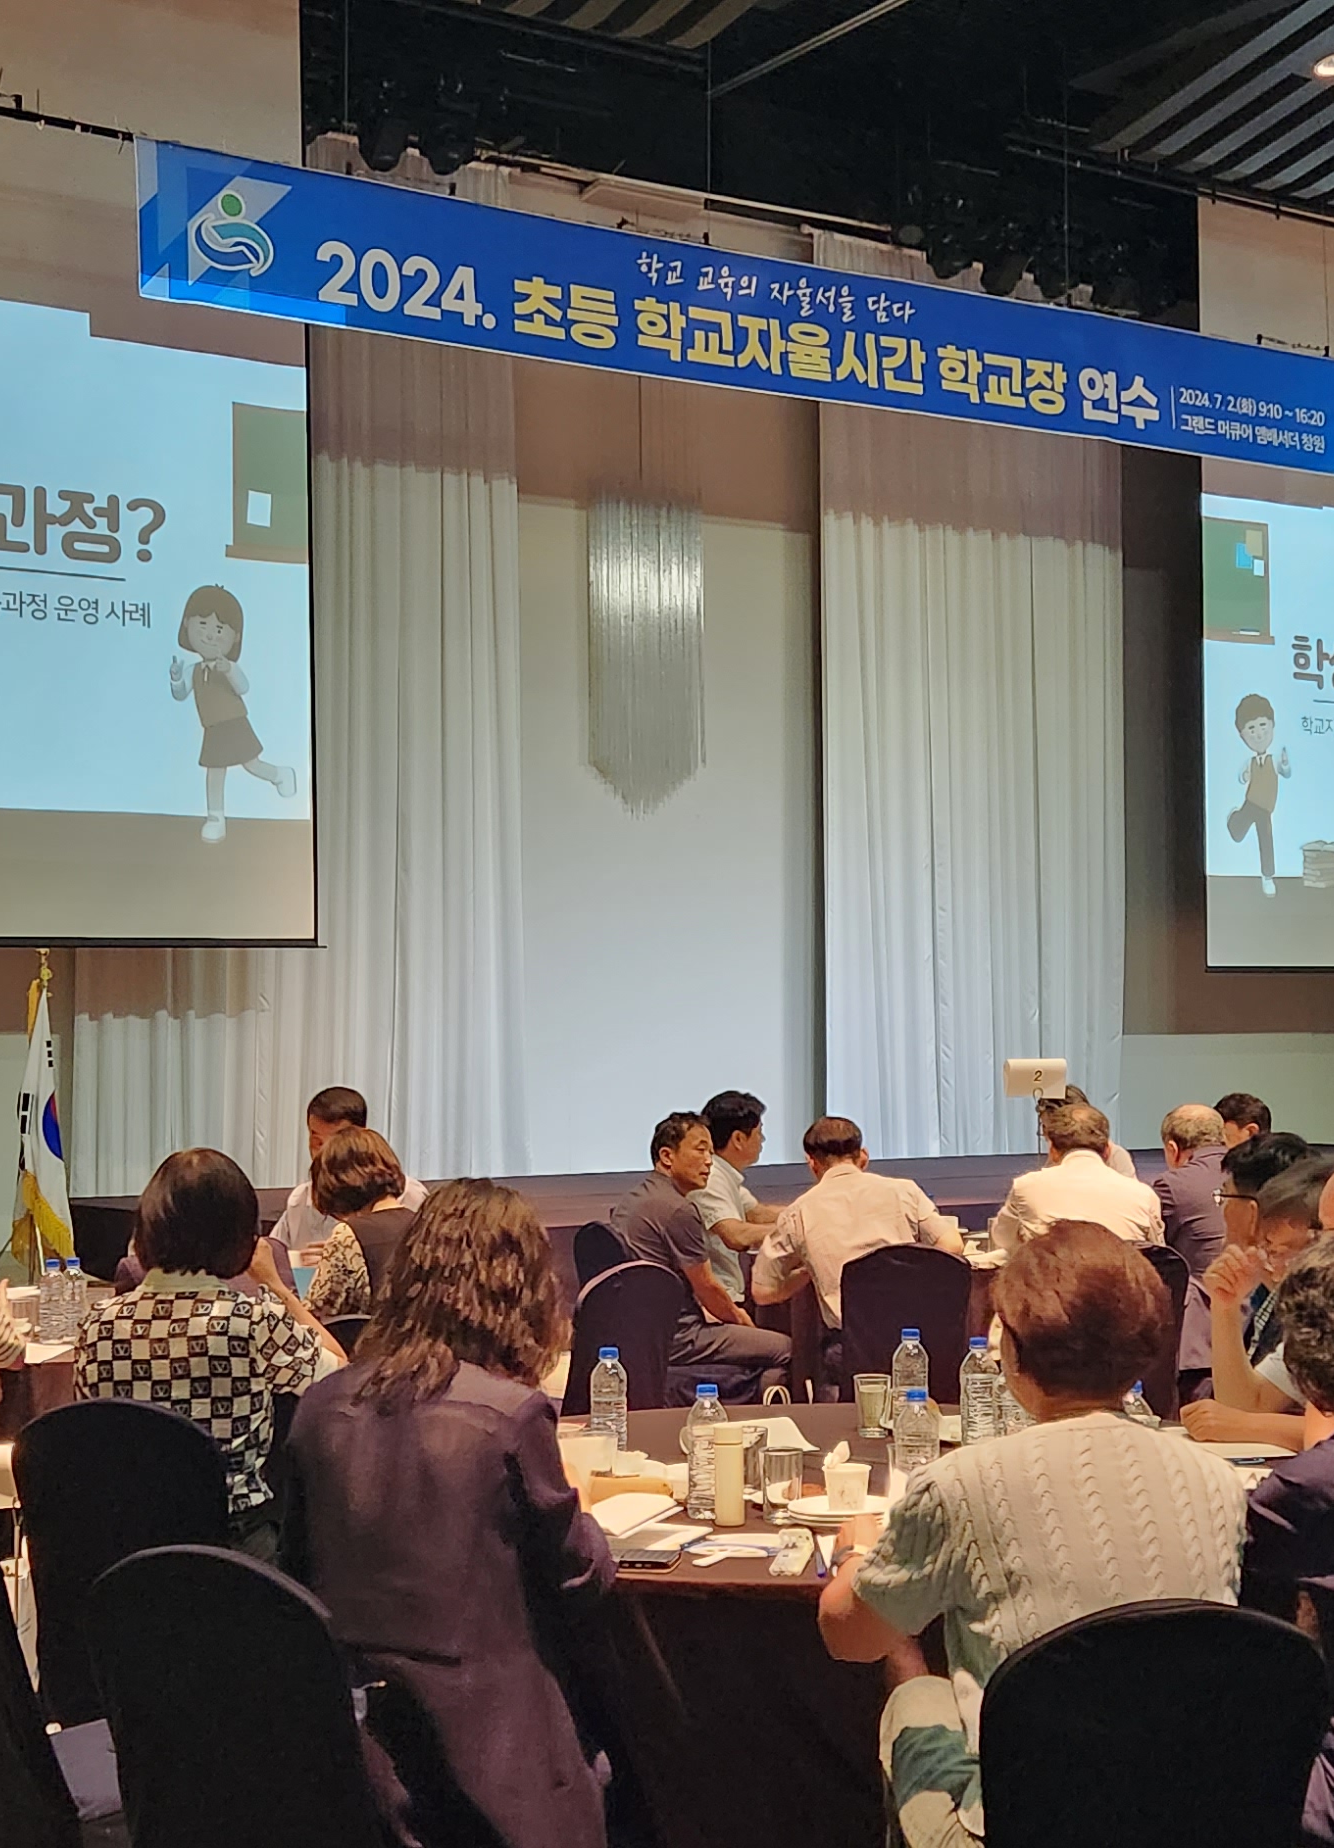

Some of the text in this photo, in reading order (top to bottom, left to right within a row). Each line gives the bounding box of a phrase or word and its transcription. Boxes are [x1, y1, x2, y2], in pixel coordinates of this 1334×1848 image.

[637, 251, 916, 324] 학교 교육의 자율성을 담다
[316, 240, 1160, 430] 2024. 초등 학교자율시간 학교장 연수
[1180, 414, 1216, 435] 그랜드
[1218, 420, 1253, 443] 머큐어
[1295, 407, 1325, 427] 16:20
[53, 595, 99, 626] 운영
[105, 600, 152, 628] 사례
[1033, 1069, 1043, 1082] 2
